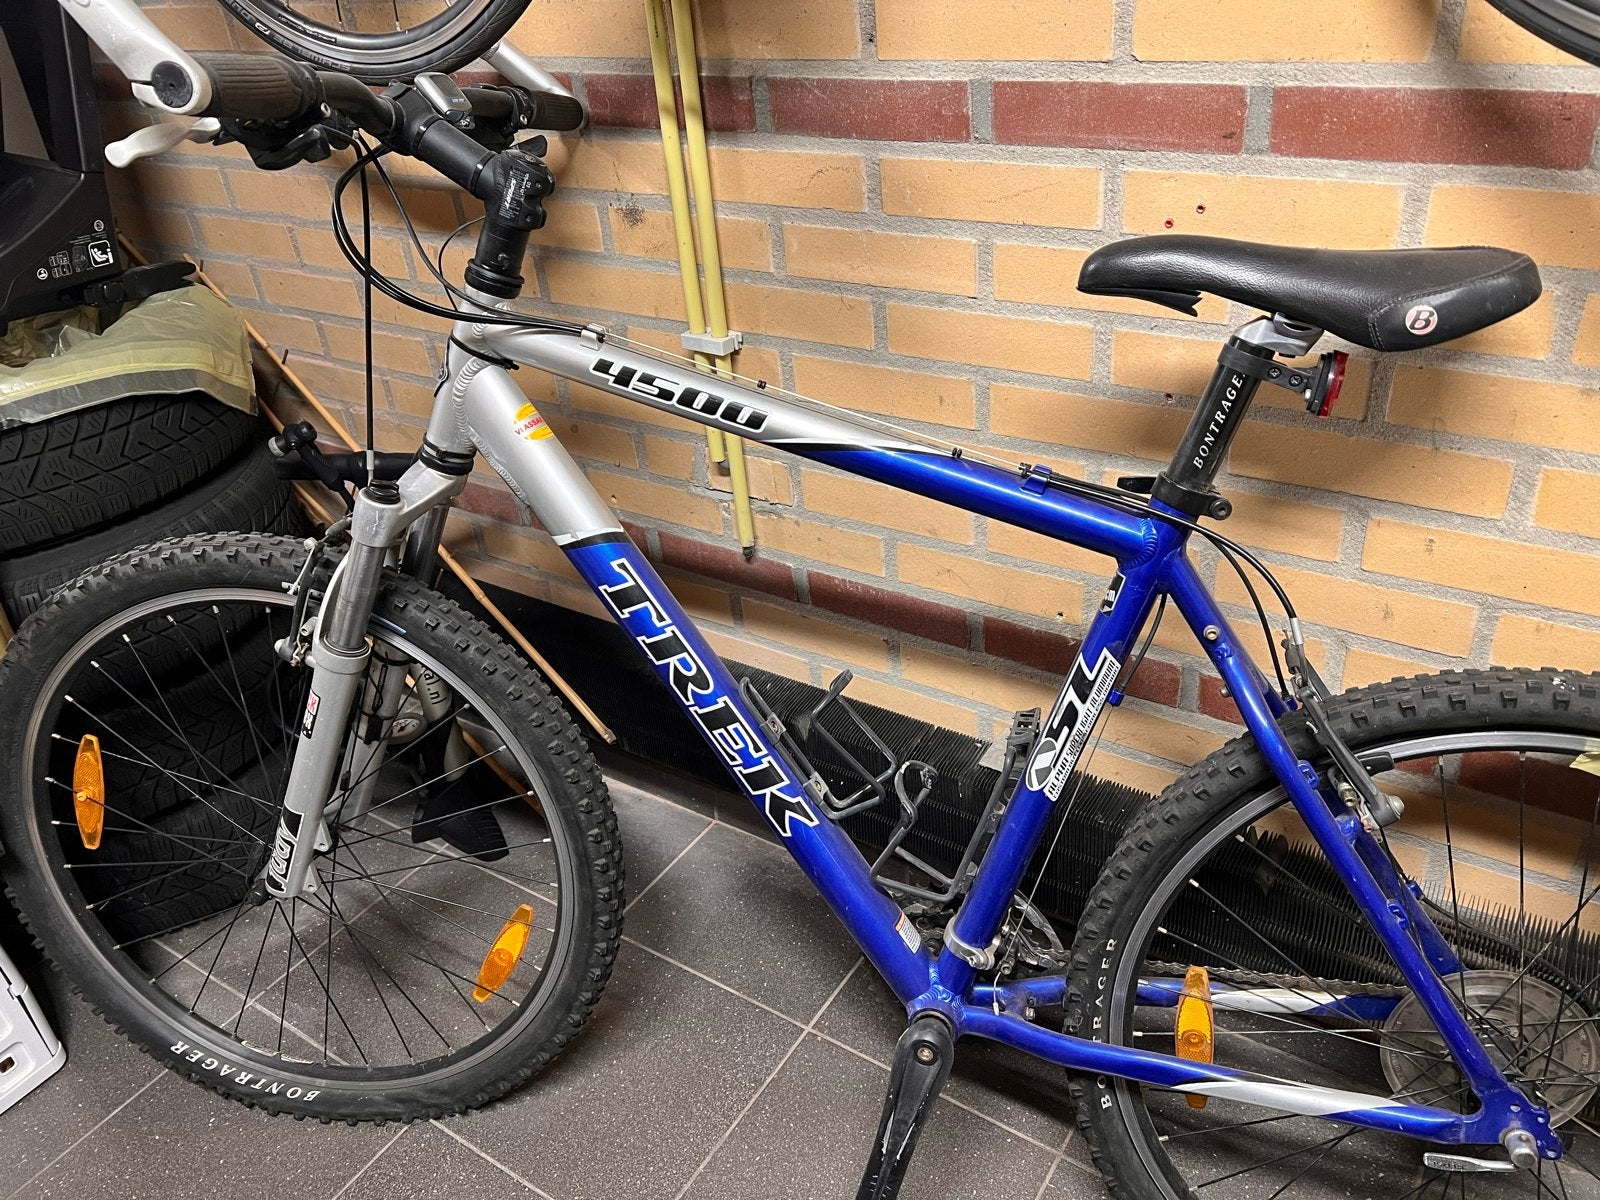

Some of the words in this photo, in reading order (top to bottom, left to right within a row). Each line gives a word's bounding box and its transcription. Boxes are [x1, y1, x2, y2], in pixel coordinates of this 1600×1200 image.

[1408, 309, 1435, 330] B
[590, 357, 770, 433] 4500
[1193, 374, 1246, 469] BONTRAGE
[598, 557, 820, 837] TREK
[1048, 756, 1070, 796] ALPHA
[1066, 707, 1093, 760] SUPERLIGHT
[1090, 659, 1116, 709] ALUMINUM
[170, 1040, 321, 1101] BONTRAGER
[1093, 938, 1117, 1109] BOTRAGER
